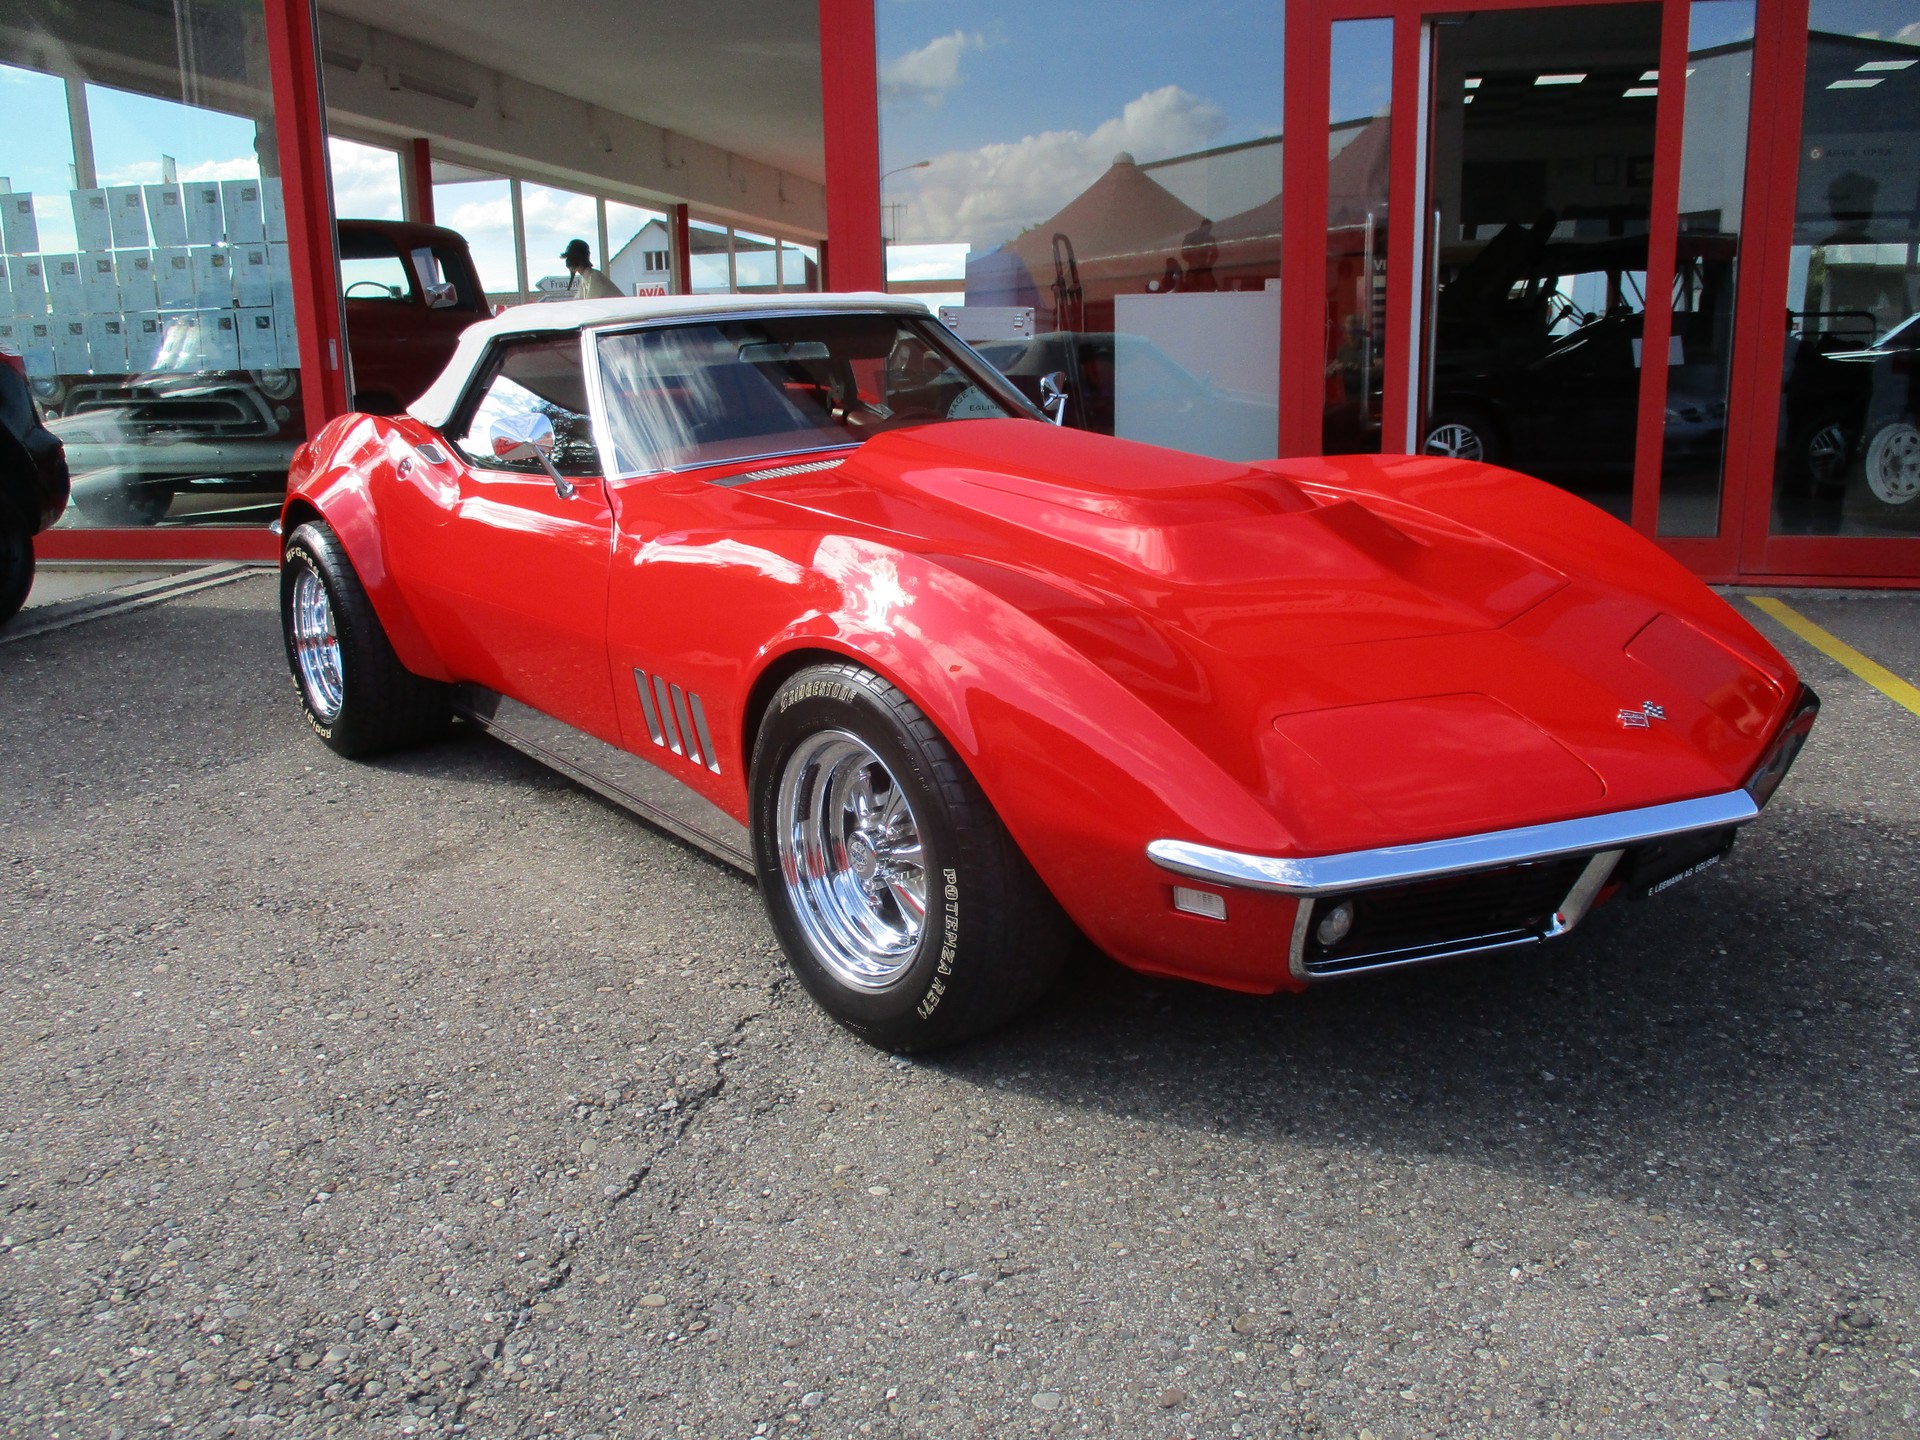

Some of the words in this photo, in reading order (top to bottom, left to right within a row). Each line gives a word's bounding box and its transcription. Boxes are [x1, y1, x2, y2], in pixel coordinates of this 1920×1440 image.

[780, 681, 858, 713] BRIDGESTONE
[937, 868, 959, 976] POTENZA
[917, 976, 947, 1020] RE71
